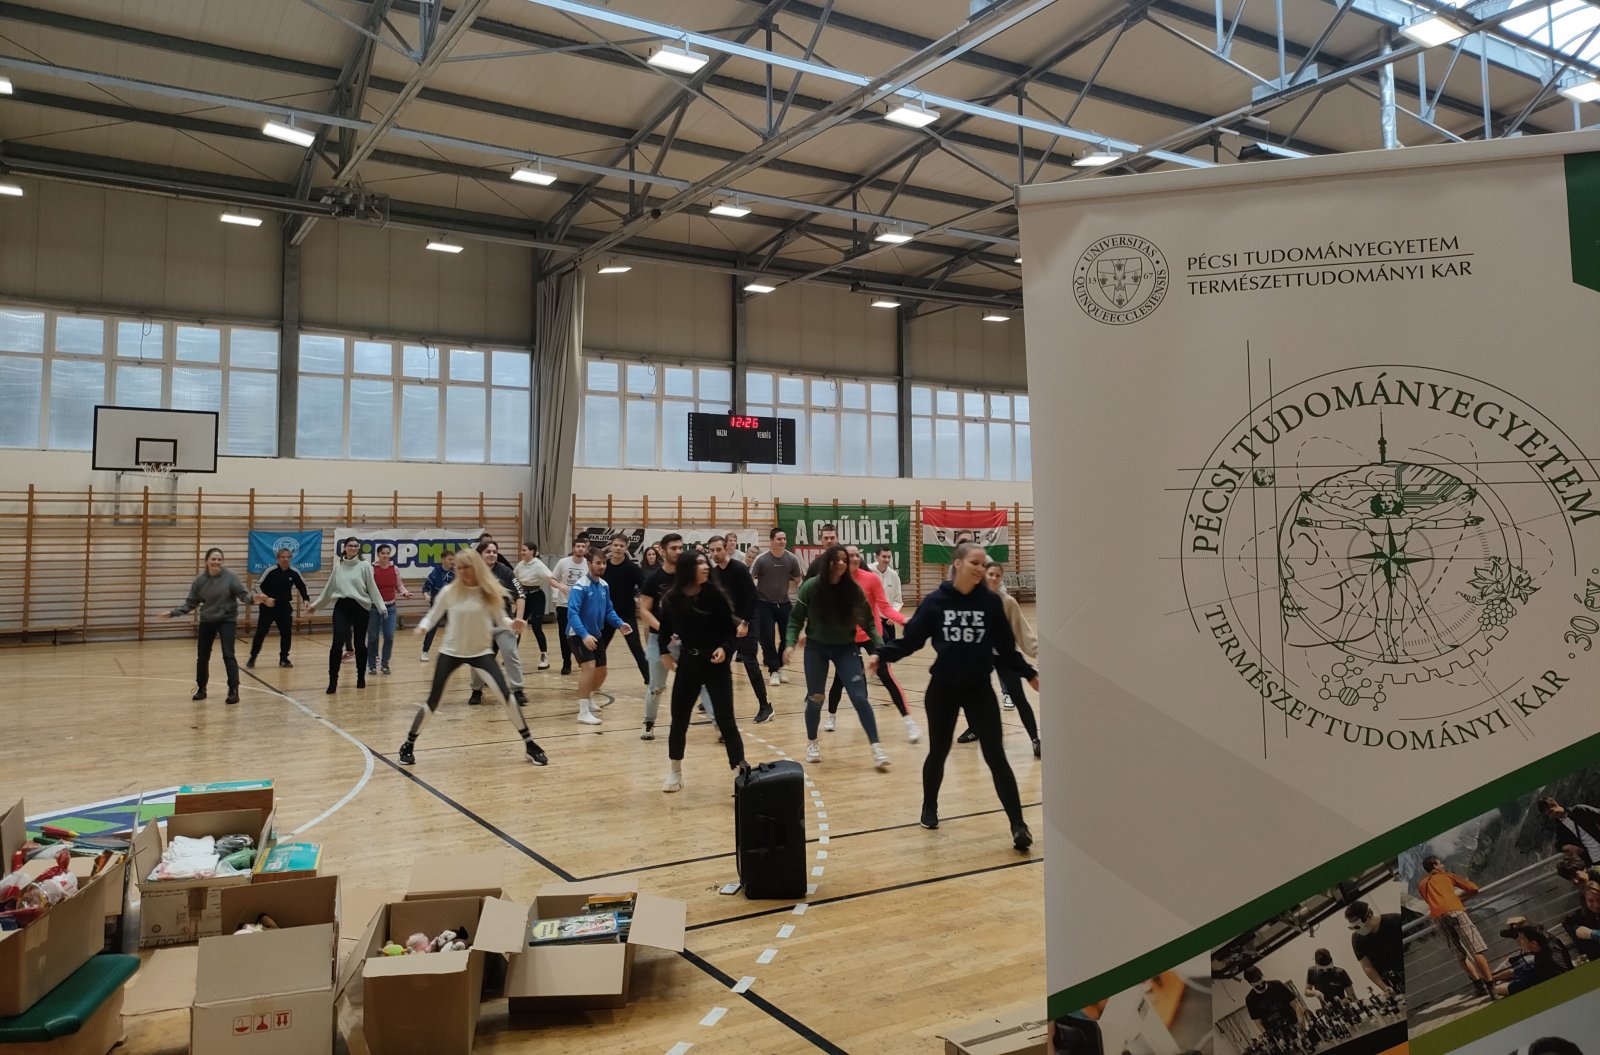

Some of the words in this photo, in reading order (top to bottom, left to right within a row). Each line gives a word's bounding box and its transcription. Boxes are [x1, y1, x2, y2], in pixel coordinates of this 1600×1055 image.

[1083, 236, 1157, 262] UNIVERSITAS
[1187, 251, 1238, 271] PÉCSI
[1243, 235, 1460, 266] TUDOMÁNYEGYETEM
[1143, 272, 1154, 280] 67
[1187, 263, 1425, 295] TERMÉSZETTUDOMÁNYI
[1431, 260, 1473, 279] KAR
[1074, 269, 1167, 323] QUINQUEECCLESIENSIS
[1188, 459, 1245, 555] PÉCSI
[1231, 371, 1600, 526] TUDOMÁNYEGYETEM
[795, 519, 809, 545] A
[942, 626, 986, 644] 1367
[943, 609, 985, 627] PTE
[1563, 615, 1600, 651] 30
[1204, 604, 1512, 751] TERMÉSZETTUDOMÁNYI
[1511, 668, 1570, 718] KAR
